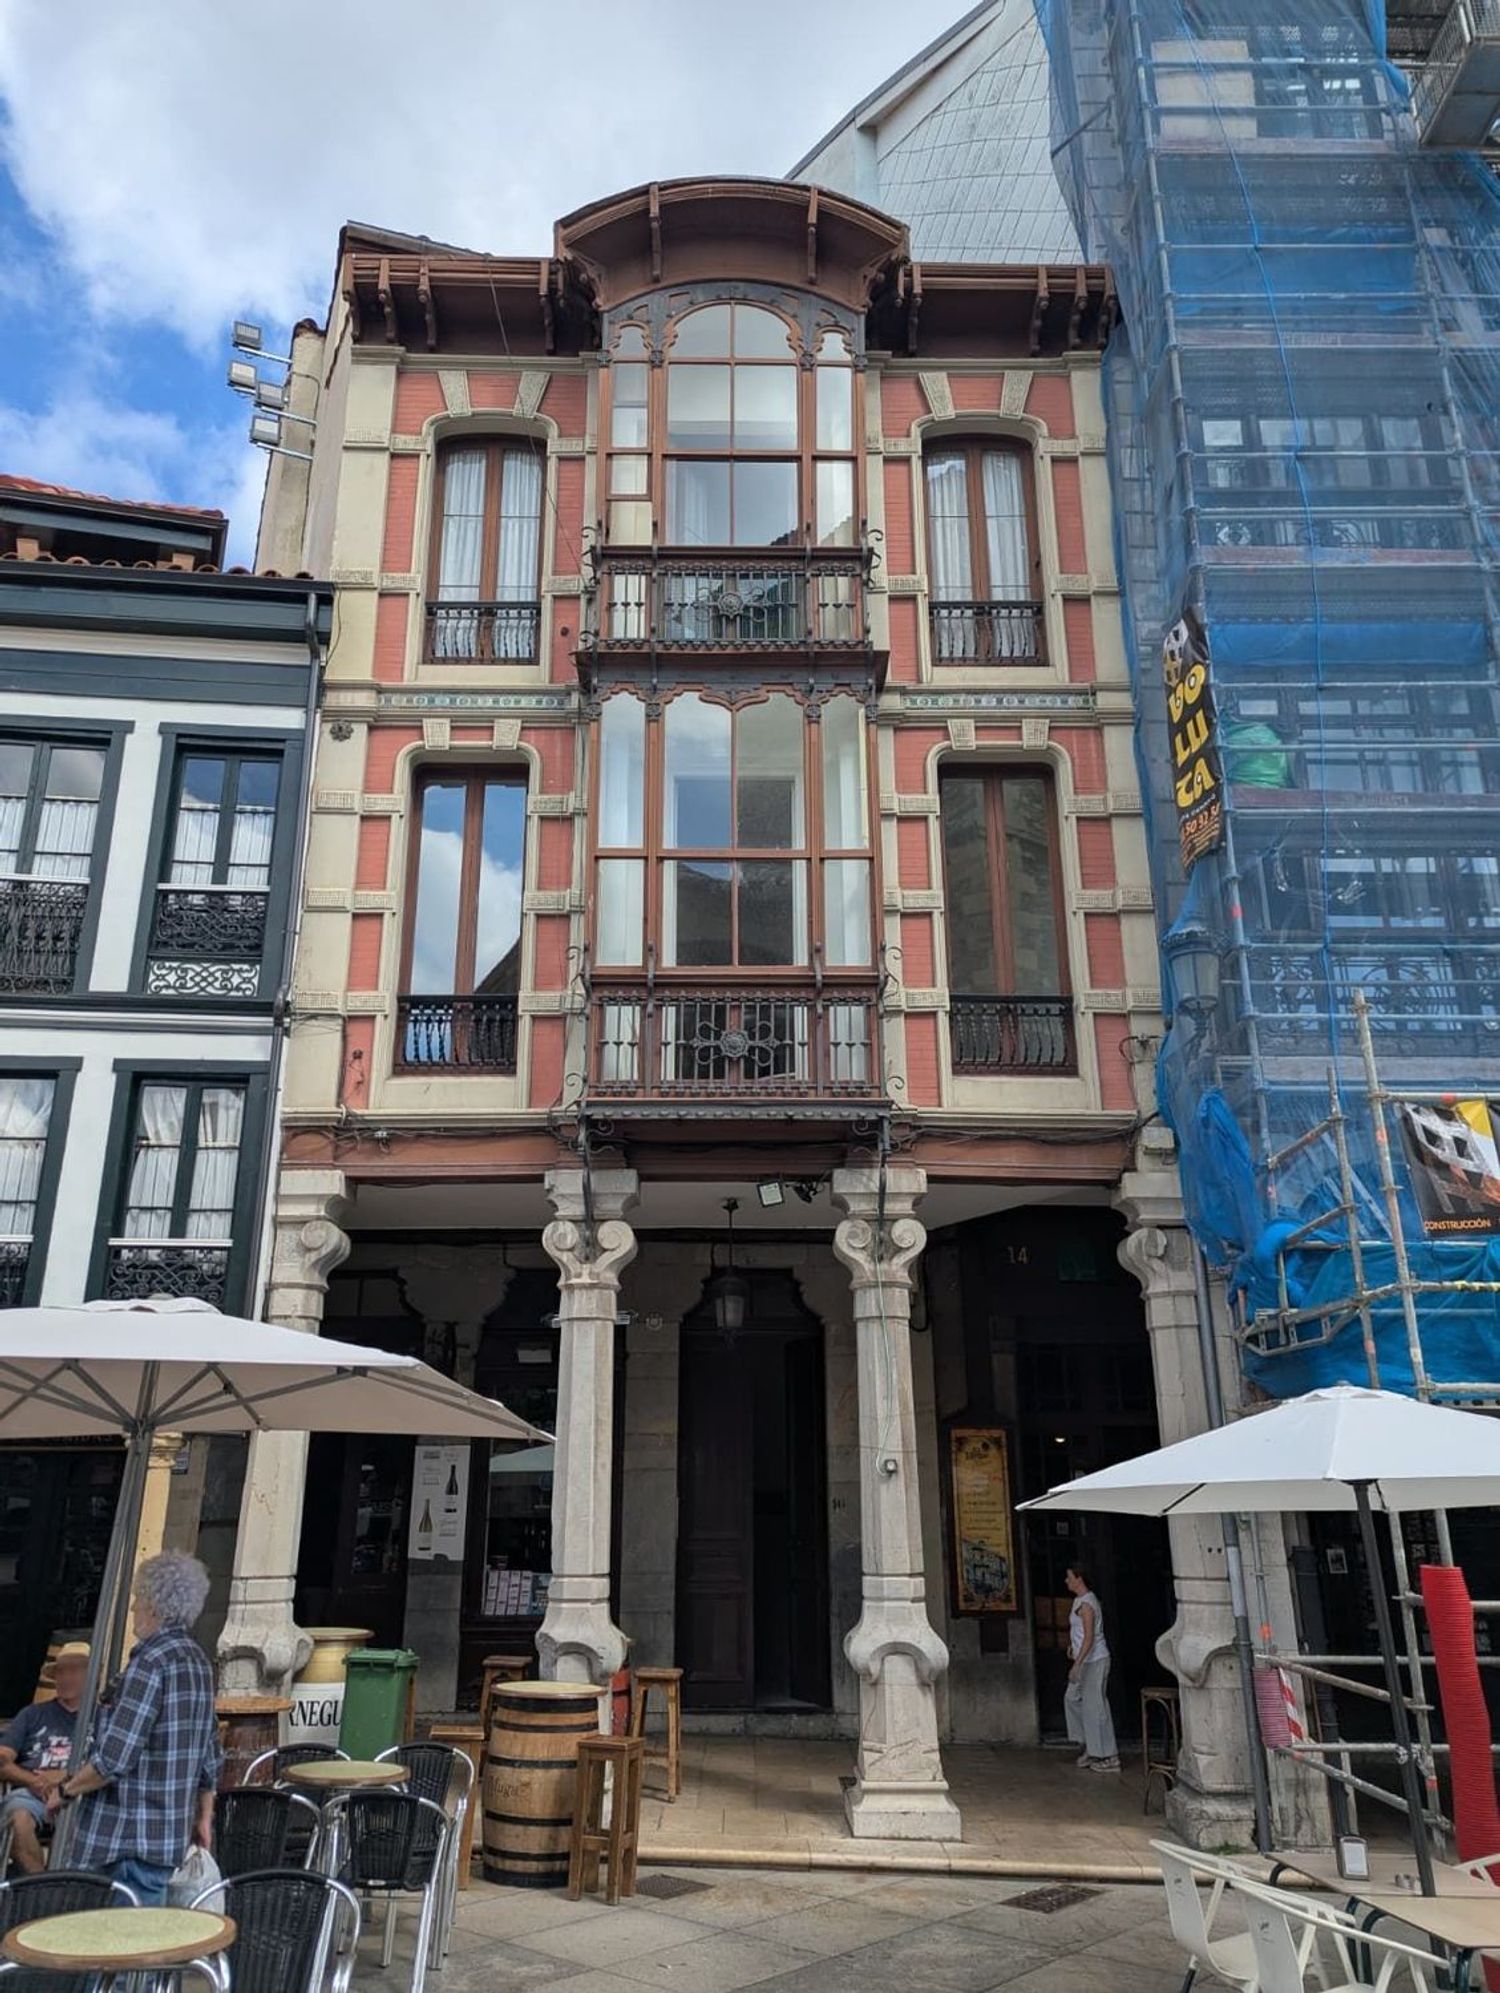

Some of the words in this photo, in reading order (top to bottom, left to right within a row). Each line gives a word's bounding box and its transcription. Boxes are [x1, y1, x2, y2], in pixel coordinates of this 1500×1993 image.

[1174, 708, 1209, 768] LU
[1175, 757, 1215, 808] TA
[1423, 1218, 1491, 1230] CONSTRUCCIÓN
[1007, 1245, 1029, 1264] 14
